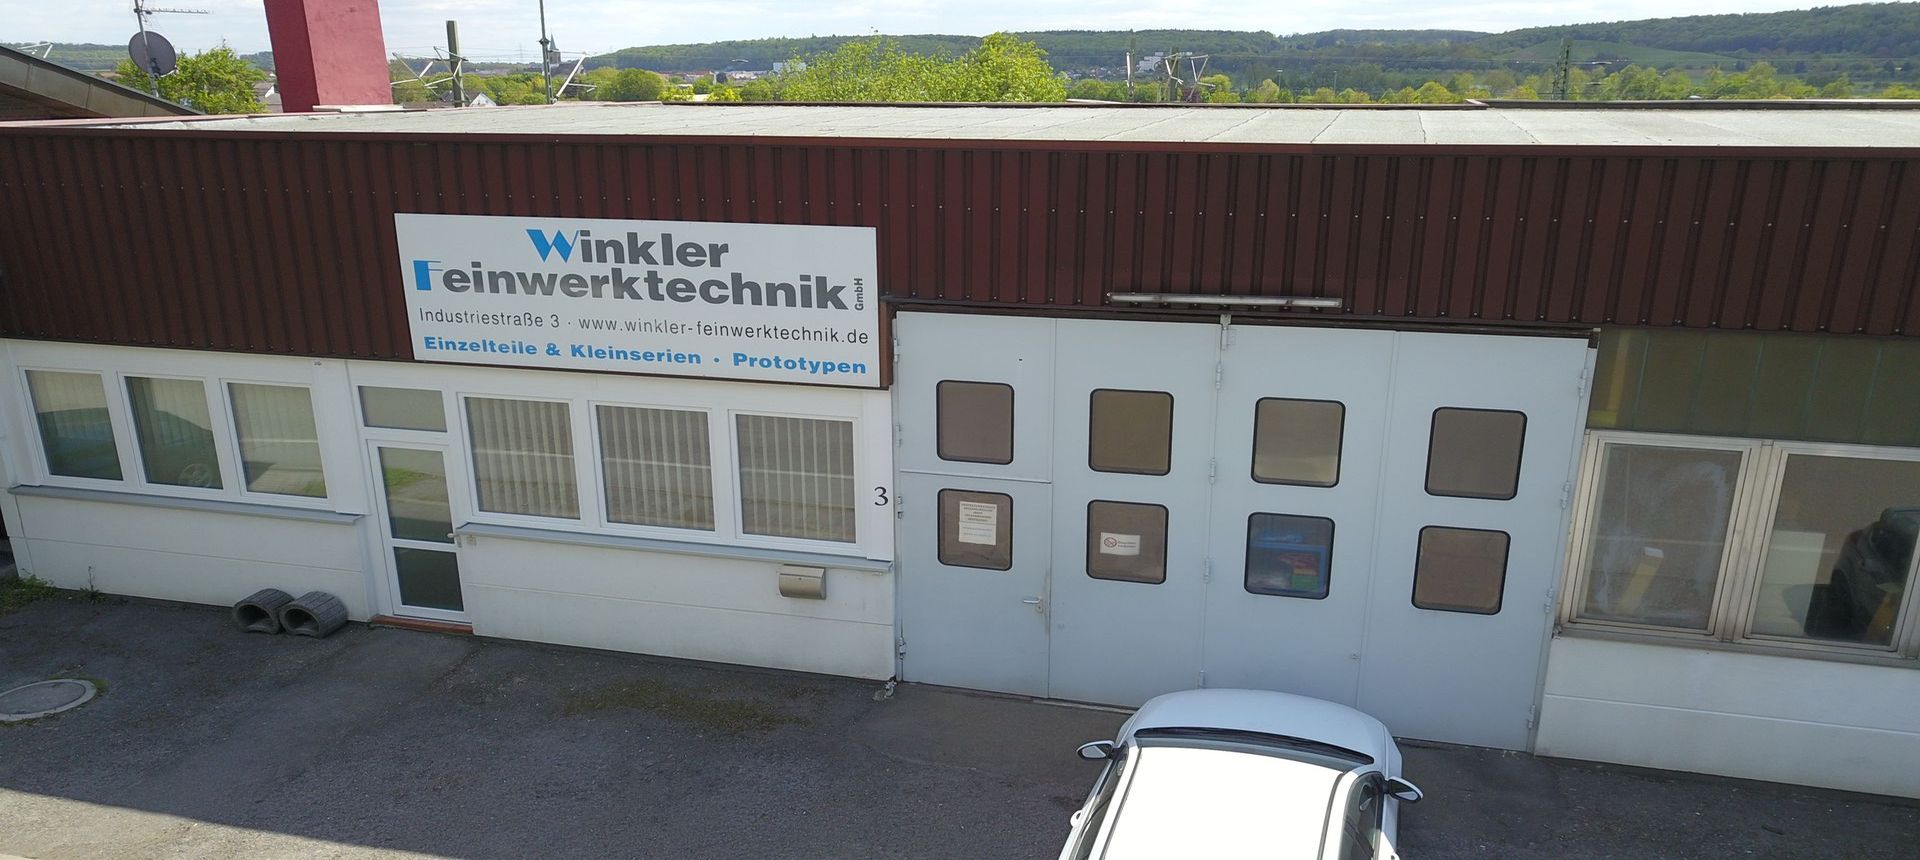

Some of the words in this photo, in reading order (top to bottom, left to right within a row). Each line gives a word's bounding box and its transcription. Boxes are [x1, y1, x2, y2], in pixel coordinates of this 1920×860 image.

[526, 229, 729, 268] Winkler
[413, 260, 849, 310] Feinwerktechnik
[853, 277, 864, 311] GmbH
[420, 307, 543, 328] Industriestraße
[550, 313, 560, 328] 3
[578, 318, 869, 344] www.winkler-feinwerktechnik.de
[424, 336, 537, 356] Einzelteile
[546, 342, 561, 357] &
[570, 344, 701, 365] Kleinserien
[733, 352, 866, 375] Prototypen
[874, 486, 889, 507] 3
